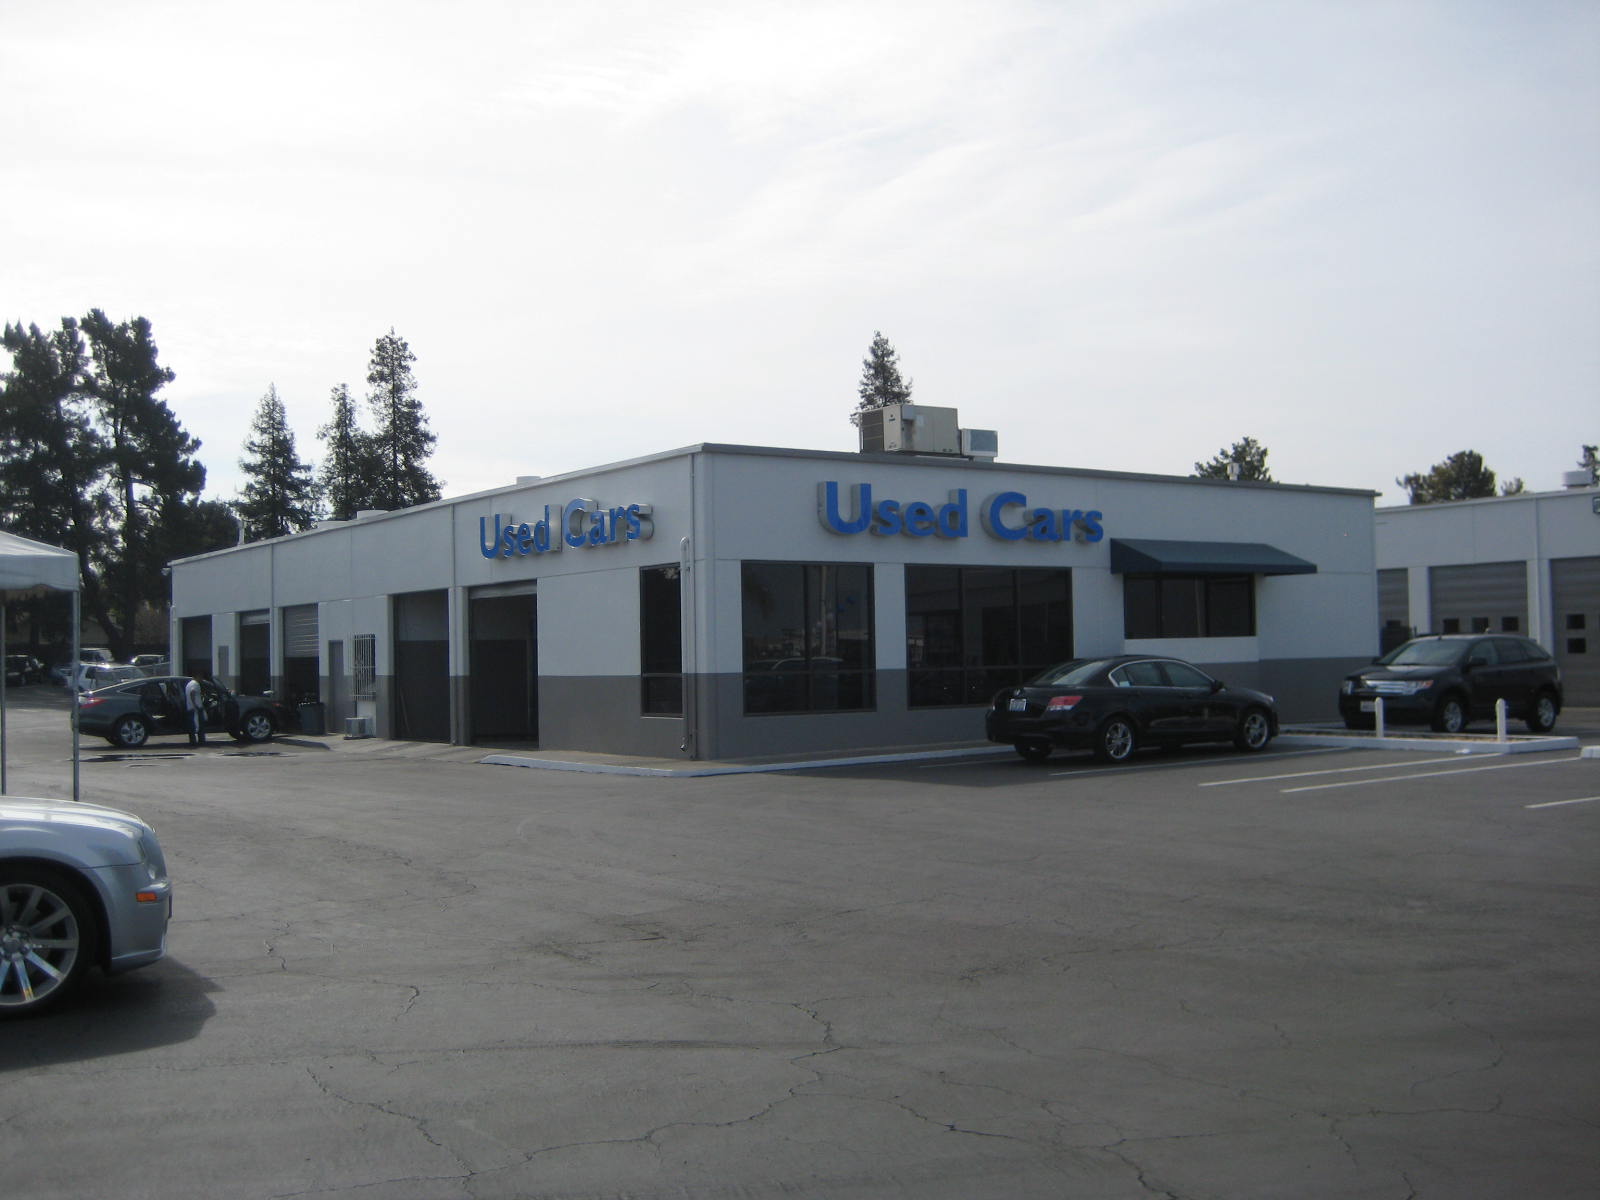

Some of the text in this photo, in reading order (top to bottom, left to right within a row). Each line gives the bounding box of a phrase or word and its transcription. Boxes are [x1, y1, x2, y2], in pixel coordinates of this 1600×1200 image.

[480, 498, 644, 558] Used Cars
[822, 480, 1105, 544] Used Cars
